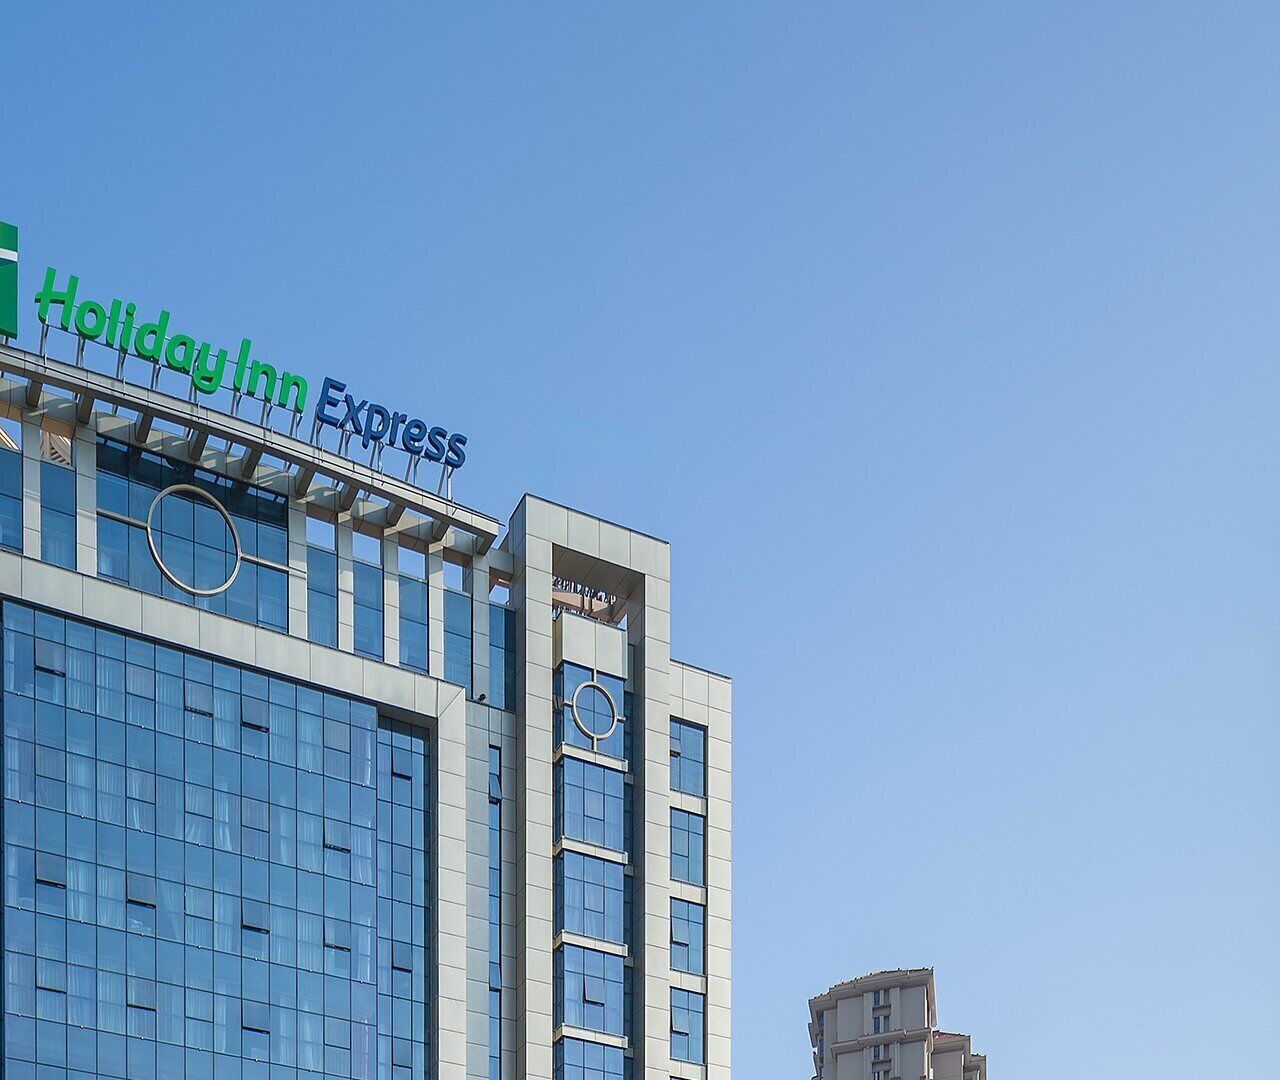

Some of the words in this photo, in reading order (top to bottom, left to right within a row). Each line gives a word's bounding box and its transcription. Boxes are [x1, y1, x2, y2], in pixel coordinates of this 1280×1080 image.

[34, 266, 227, 395] Holiday
[233, 337, 307, 415] Inn
[316, 376, 468, 469] Express
